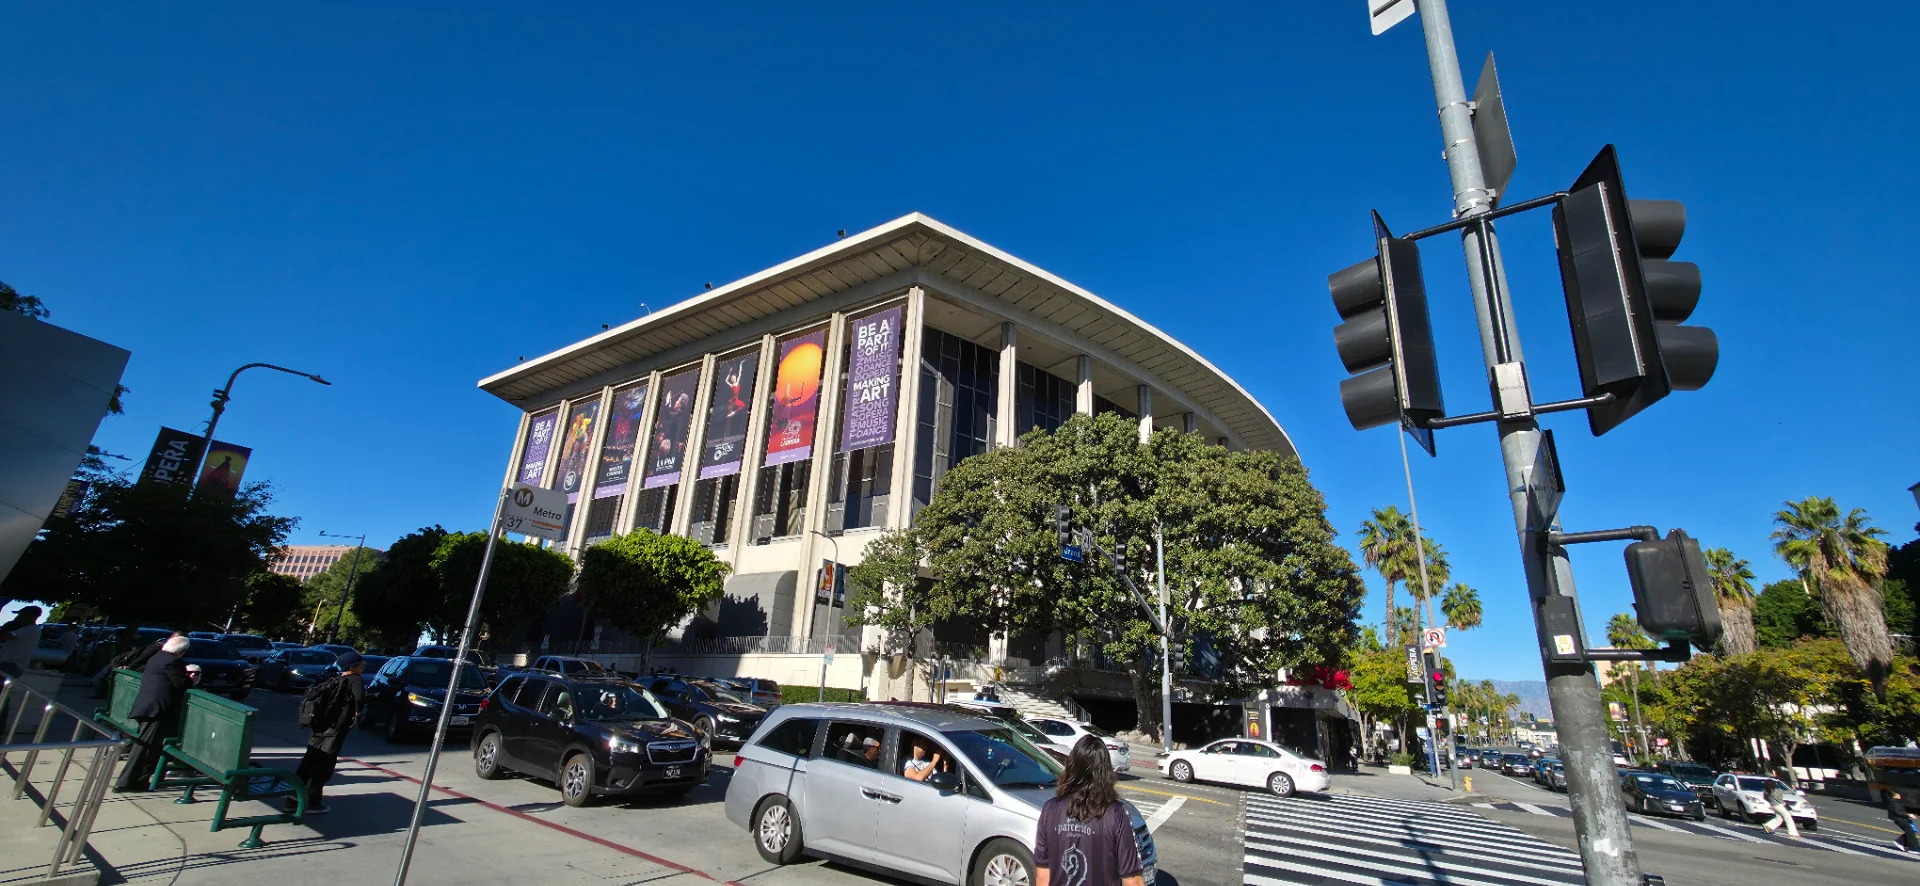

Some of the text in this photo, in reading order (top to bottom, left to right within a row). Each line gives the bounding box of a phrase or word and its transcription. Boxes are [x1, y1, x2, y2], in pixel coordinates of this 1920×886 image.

[858, 319, 890, 339] BE A
[857, 331, 890, 350] PART
[865, 342, 889, 356] OF IT
[864, 349, 892, 364] MUSIC
[863, 358, 892, 372] DANCE
[862, 367, 891, 380] OPERA
[853, 374, 890, 391] MAKING
[860, 382, 890, 403] ART
[859, 398, 889, 413] SONG
[849, 391, 861, 440] THEATRE
[858, 408, 889, 421] OPERA
[535, 420, 551, 431] BE A
[857, 415, 888, 429] MUSIC
[533, 430, 549, 441] PART
[856, 425, 888, 439] DANCE
[526, 467, 543, 479] ART
[533, 506, 562, 520] Metro
[507, 516, 523, 530] 37
